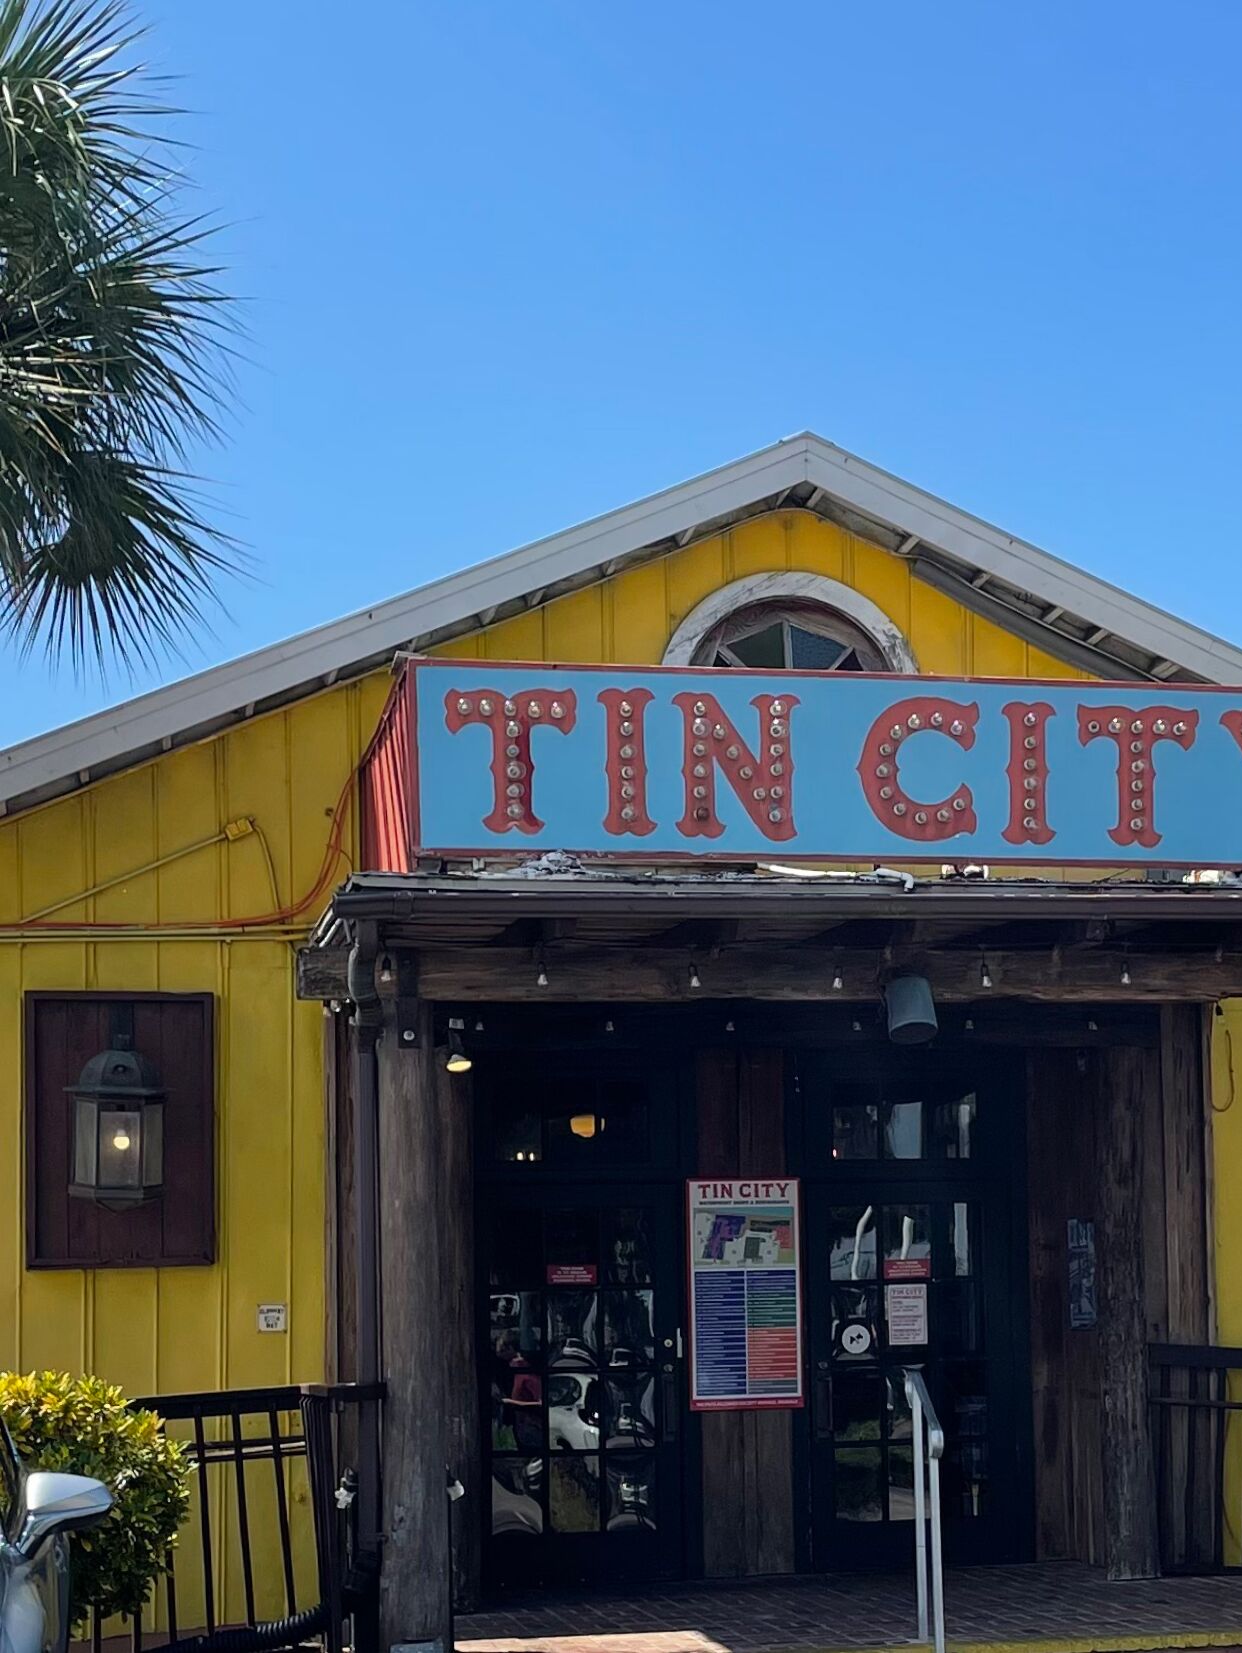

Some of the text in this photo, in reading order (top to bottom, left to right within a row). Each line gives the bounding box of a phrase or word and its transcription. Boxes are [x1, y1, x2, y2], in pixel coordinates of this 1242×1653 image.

[443, 687, 801, 842] TIN
[697, 1183, 790, 1199] TIN CITY
